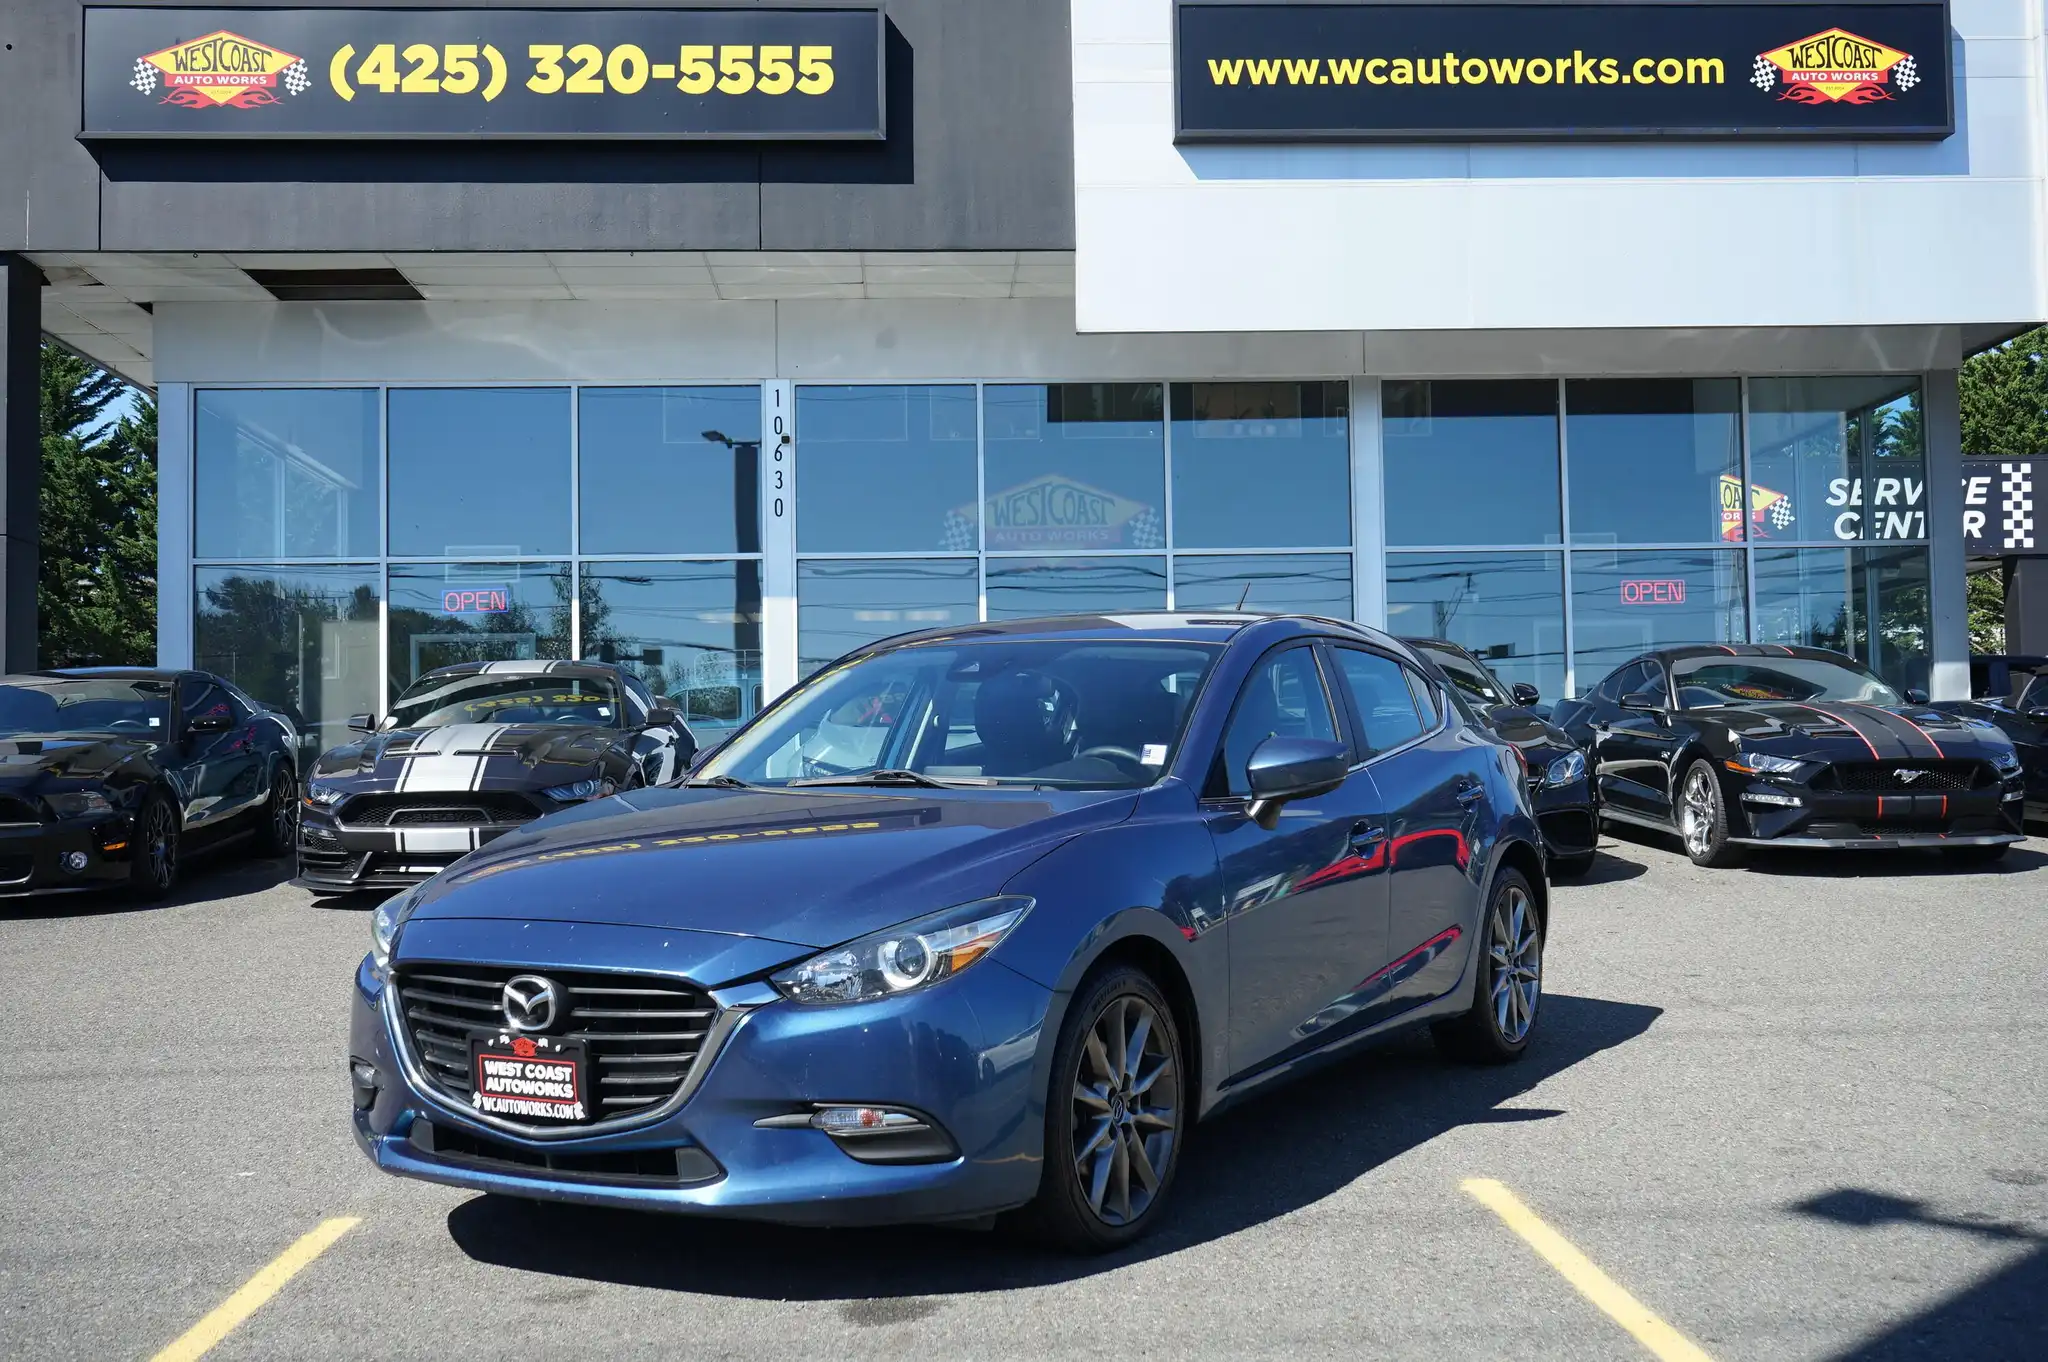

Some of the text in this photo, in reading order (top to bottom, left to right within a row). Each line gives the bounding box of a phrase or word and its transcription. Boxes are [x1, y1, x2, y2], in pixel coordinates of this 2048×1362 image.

[329, 44, 835, 102] (425) 320-5555
[1208, 50, 1725, 85] www.wcautoworks.com
[1792, 72, 1879, 81] AUTO WORKS
[174, 76, 267, 85] AUTO WORKS
[773, 388, 784, 518] 10630
[996, 529, 1109, 543] AUTO WORKS
[445, 591, 505, 612] OPEN
[1625, 582, 1682, 601] OPEN
[484, 1060, 572, 1082] WEST COAST
[485, 1077, 574, 1099] AUTOWORKS
[482, 1096, 574, 1120] WCAUTOWORKS.COM
